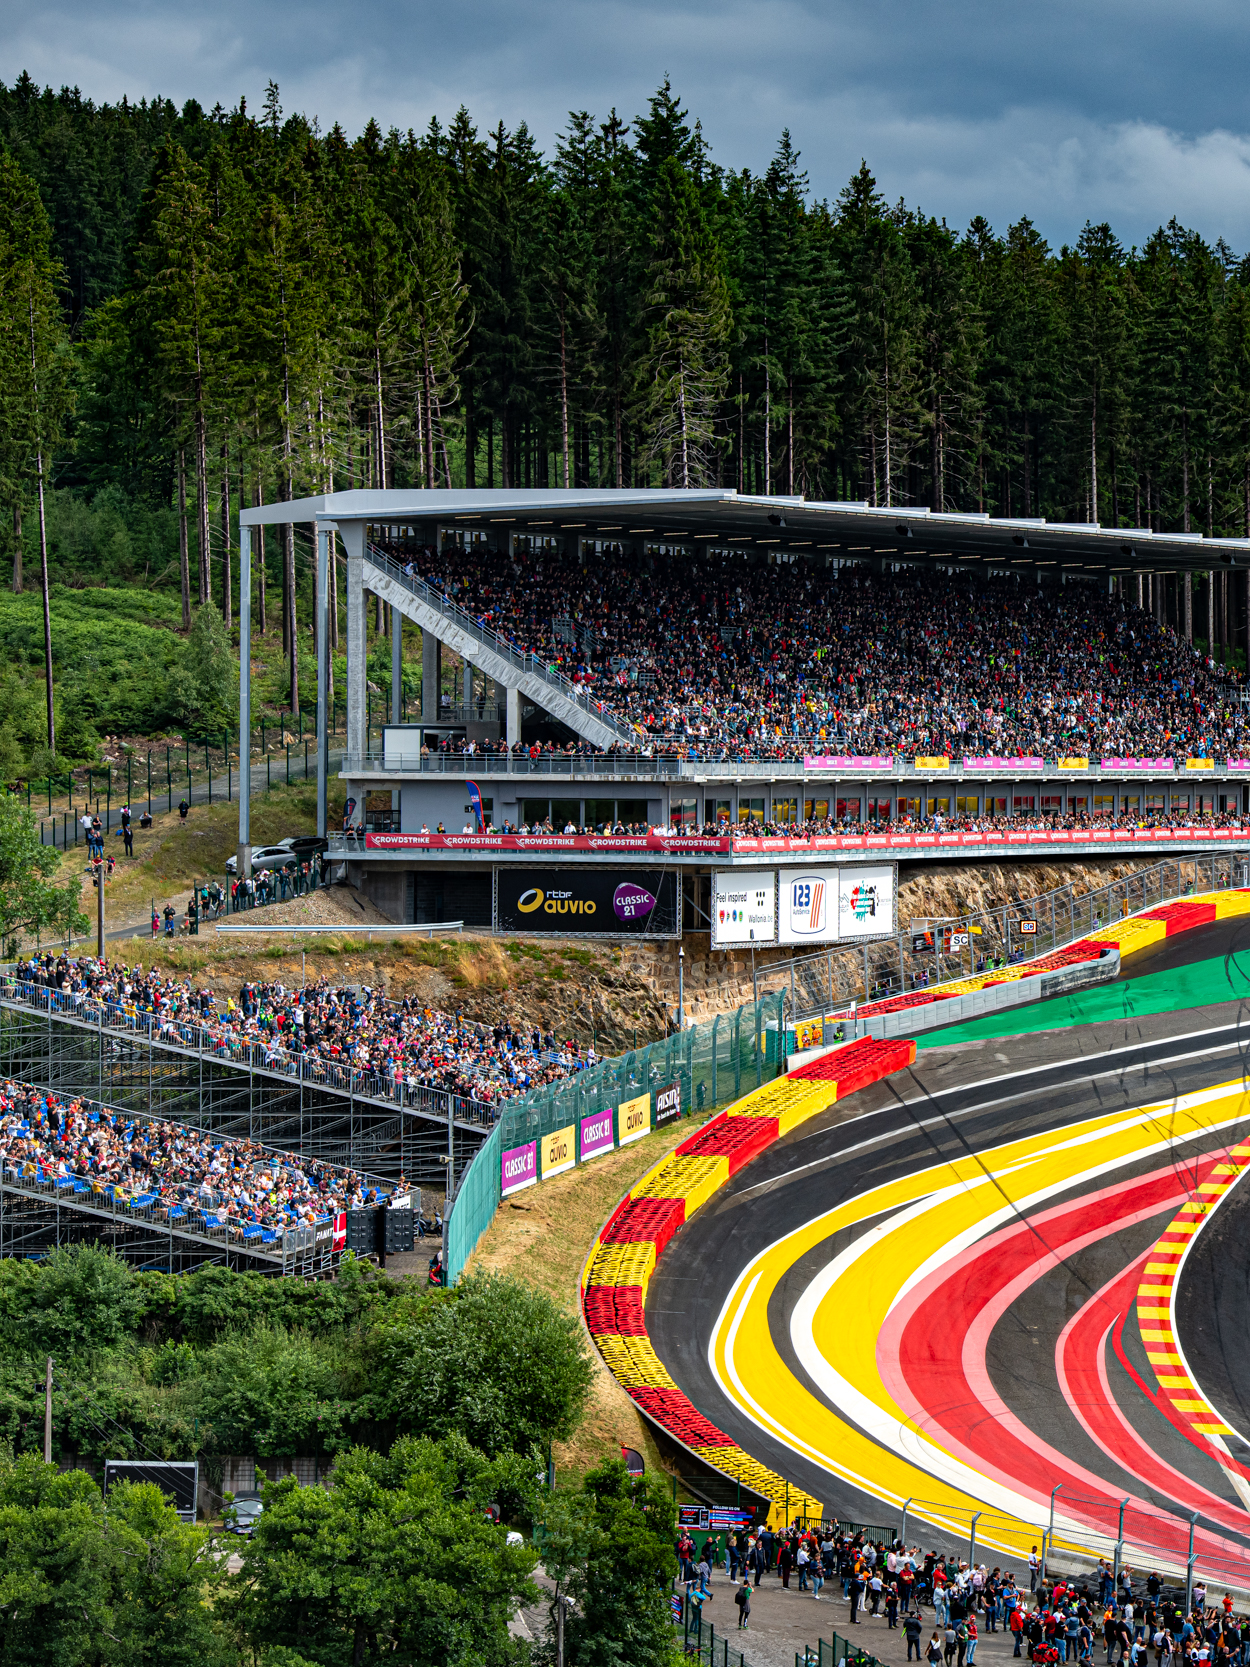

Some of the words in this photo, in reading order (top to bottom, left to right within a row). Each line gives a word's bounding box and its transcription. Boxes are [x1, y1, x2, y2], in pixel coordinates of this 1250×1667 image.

[375, 836, 430, 844] CROWDSTRIKE
[447, 837, 502, 845] CROWDSTRIKE
[520, 838, 574, 846] CROWDSTRIKE
[592, 838, 647, 846] CROWDSTRIKE
[664, 839, 720, 847] CROWDSTRIKE
[546, 890, 572, 899] rtbf
[716, 893, 726, 902] Feel
[728, 892, 747, 904] inspired
[794, 884, 811, 907] 123
[616, 894, 650, 906] CLASSIC
[544, 900, 596, 914] auvio
[624, 905, 635, 916] 21
[954, 936, 968, 944] SC
[584, 1123, 603, 1144] CLASSIC
[604, 1118, 610, 1136] 21
[505, 1156, 526, 1178] CLASSIC
[527, 1152, 533, 1172] 21
